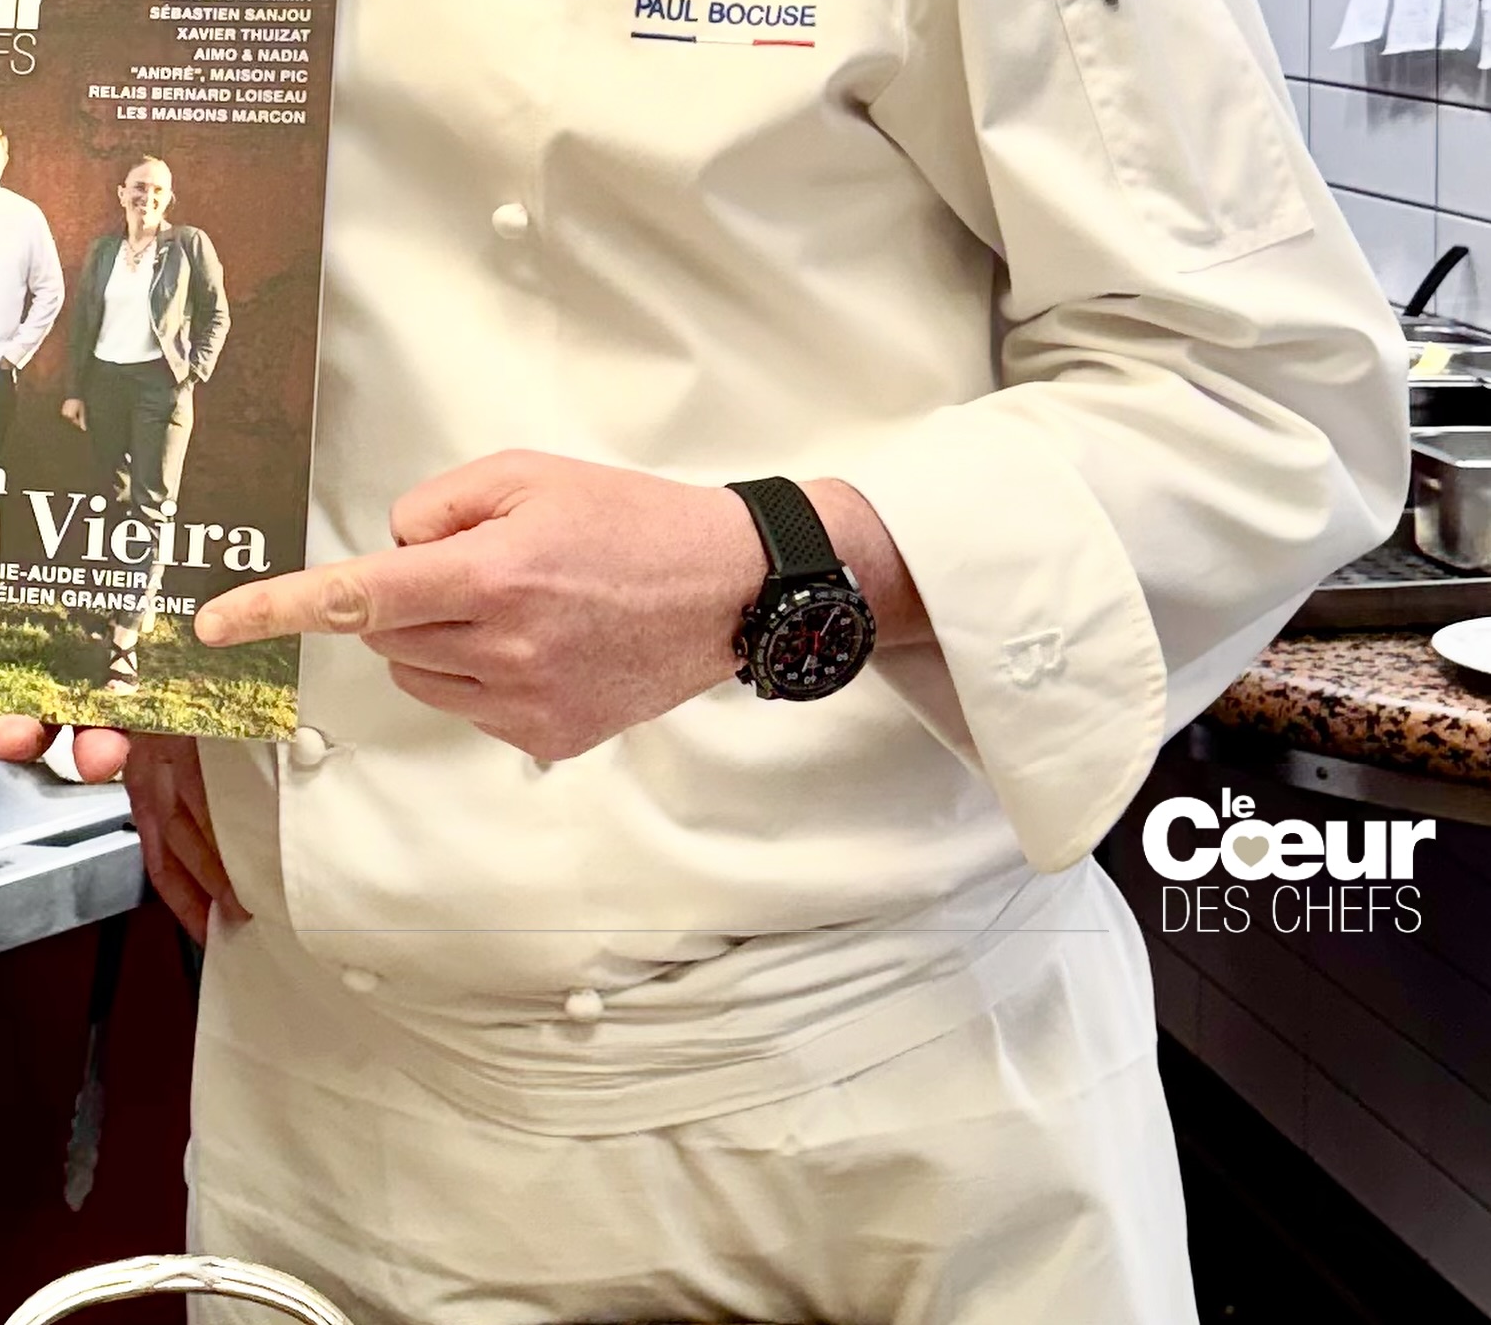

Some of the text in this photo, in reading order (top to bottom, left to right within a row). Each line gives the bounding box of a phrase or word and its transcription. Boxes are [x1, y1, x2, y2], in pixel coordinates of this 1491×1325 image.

[150, 4, 311, 22] SÉBASTIEN SANJOU
[708, 1, 816, 27] BOCUSE
[177, 27, 311, 42] XAVIER THUIZAT
[194, 48, 309, 63] AIMO & NADIA
[210, 68, 275, 82] MAISON
[280, 69, 308, 82] PIC
[88, 85, 307, 103] RELAIS BERNARD LOISEAU
[117, 106, 306, 124] LES MAISONS MARCON
[22, 490, 271, 574] Vieira
[92, 570, 162, 590] VIEIRA
[61, 589, 196, 616] GRANSAGNE
